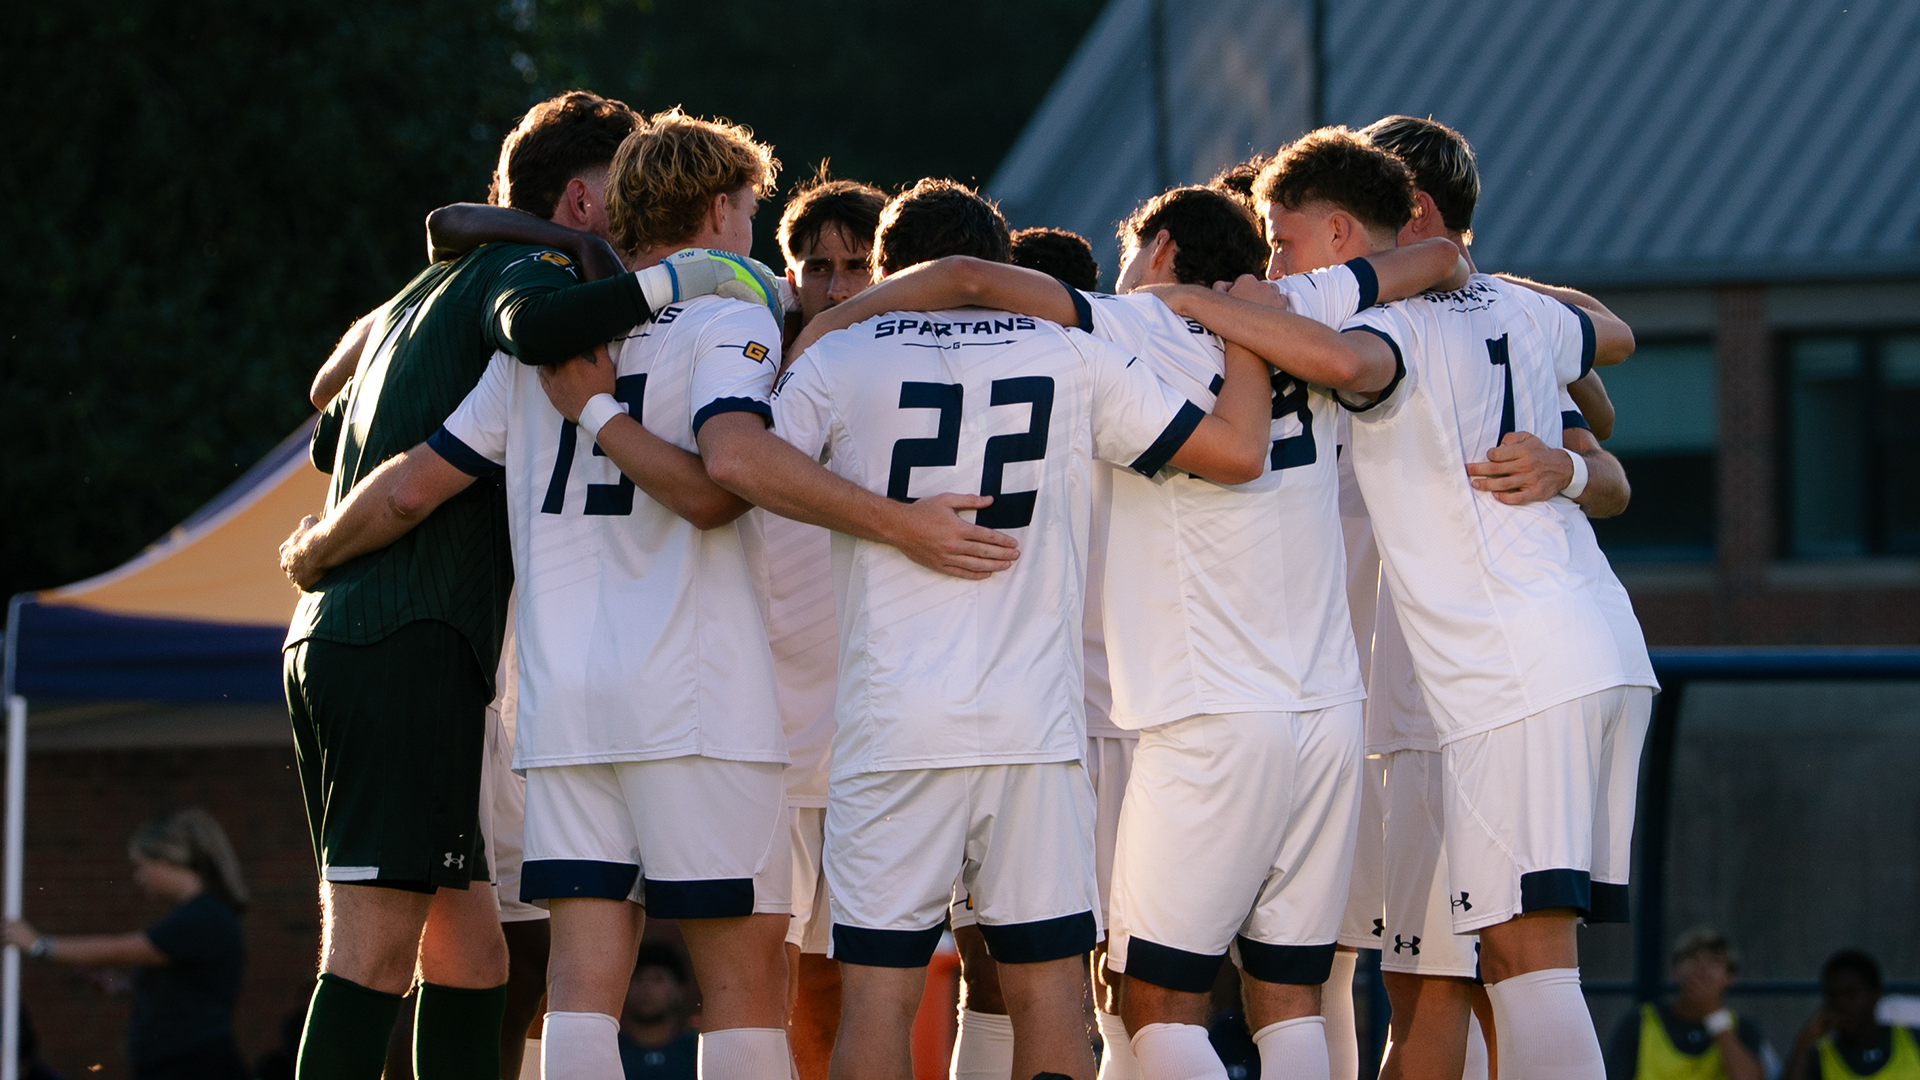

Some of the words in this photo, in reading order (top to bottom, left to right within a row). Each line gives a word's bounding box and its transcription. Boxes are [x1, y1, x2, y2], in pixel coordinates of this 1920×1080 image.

[678, 250, 696, 259] SW
[874, 317, 1037, 339] SPARTANS
[744, 342, 768, 363] G
[886, 375, 1056, 530] 22
